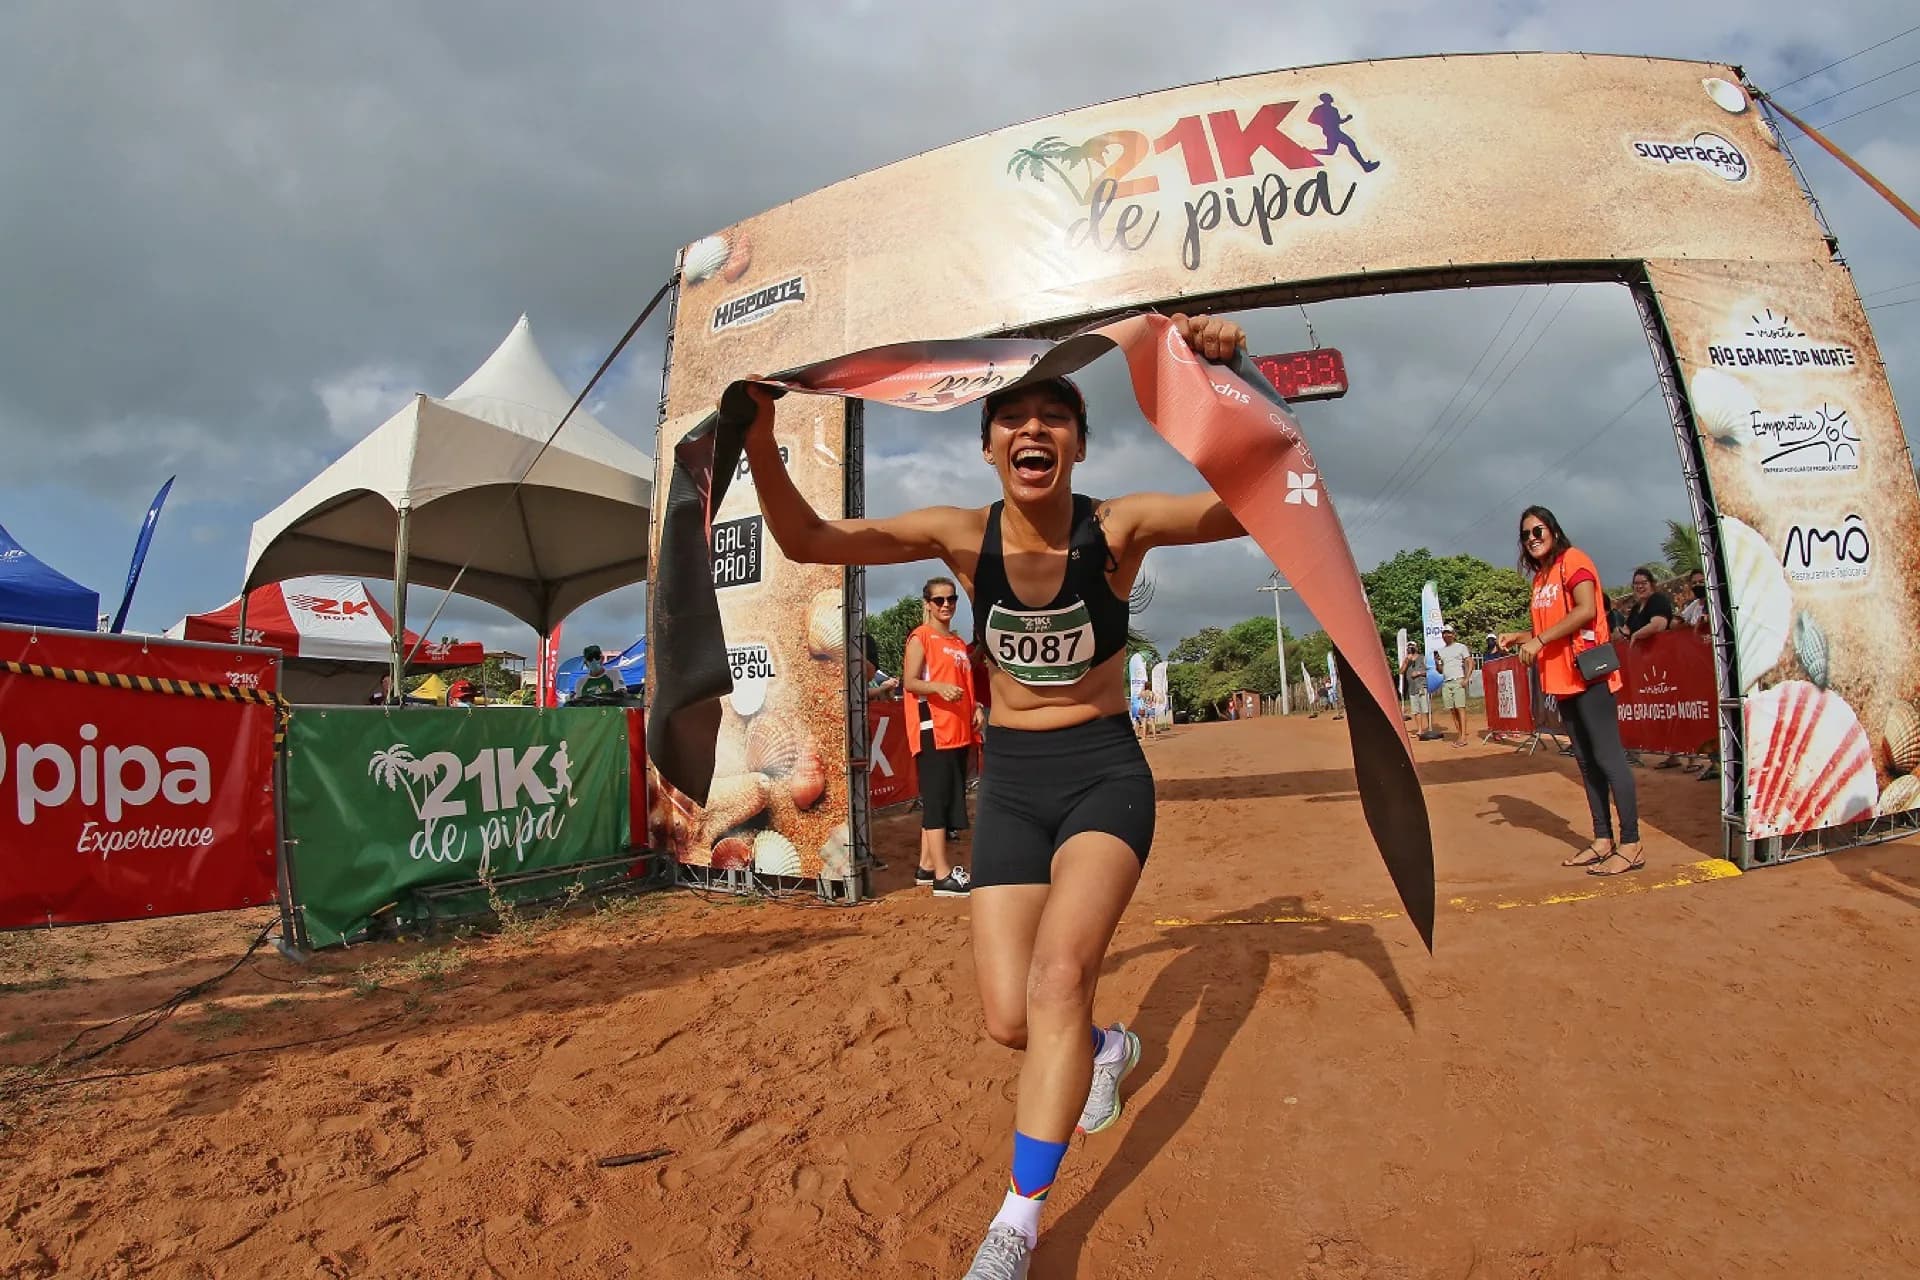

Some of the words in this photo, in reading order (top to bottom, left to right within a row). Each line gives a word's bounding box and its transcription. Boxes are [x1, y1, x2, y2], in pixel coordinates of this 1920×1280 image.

[1084, 100, 1325, 207] 21K
[1634, 142, 1745, 167] superação
[1064, 178, 1161, 253] de
[1182, 170, 1358, 271] pipa
[713, 276, 803, 328] HISPORTS
[715, 525, 746, 553] GAL
[714, 551, 746, 584] PÃO
[999, 630, 1083, 663] 5087
[747, 664, 776, 679] SUL
[16, 722, 212, 826] pipa
[419, 744, 555, 819] 21K
[77, 821, 214, 862] Experience
[409, 815, 467, 863] de
[477, 805, 566, 874] pipa
